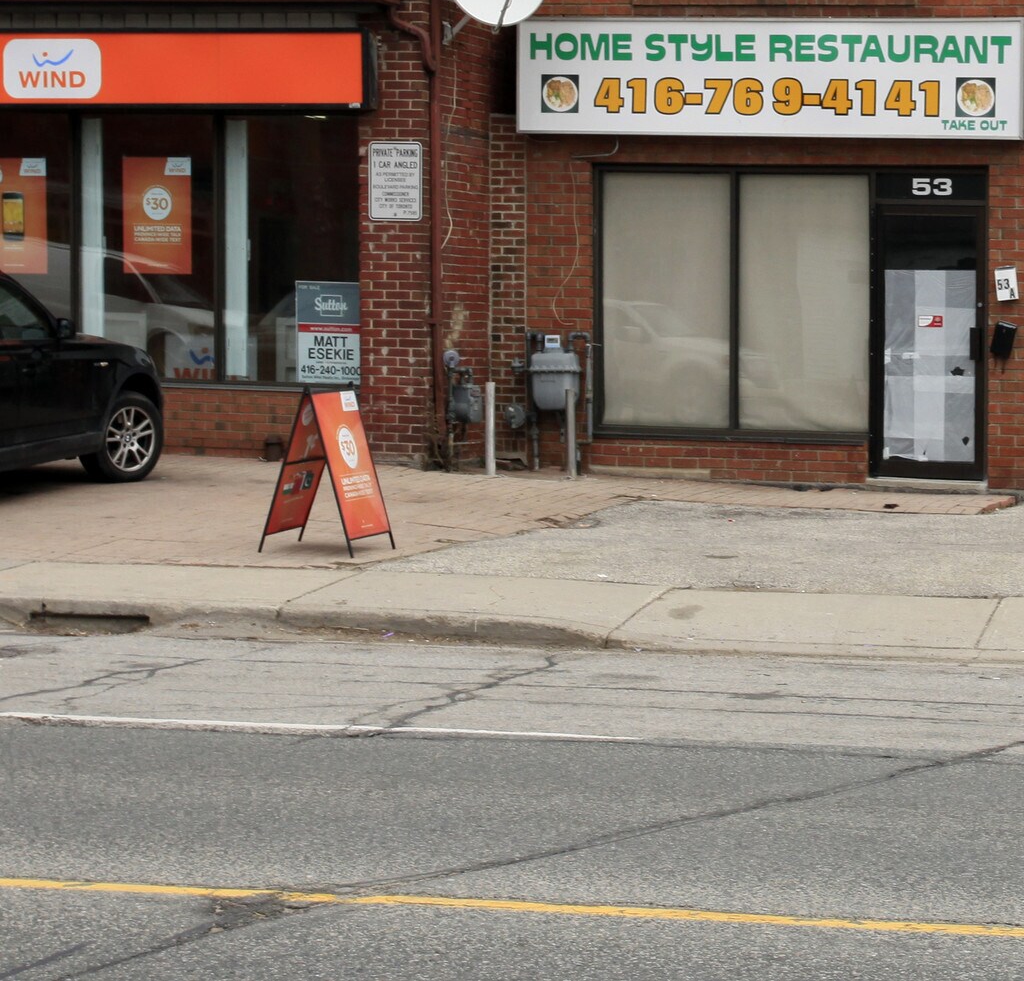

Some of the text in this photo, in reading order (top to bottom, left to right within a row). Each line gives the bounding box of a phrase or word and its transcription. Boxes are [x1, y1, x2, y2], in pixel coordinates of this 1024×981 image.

[530, 33, 1012, 64] HOME STYLE RESTAURANT
[18, 70, 86, 89] WIND
[941, 120, 1007, 131] TAKE OUT
[372, 148, 418, 158] PRIVATE PARKING
[379, 161, 391, 169] CAR
[394, 161, 418, 169] ANGLED
[912, 178, 953, 196] 53
[146, 198, 169, 210] $30
[997, 279, 1016, 298] 53 A
[314, 297, 348, 311] Sutton
[314, 335, 348, 348] MATT
[308, 348, 354, 360] ESEKIE
